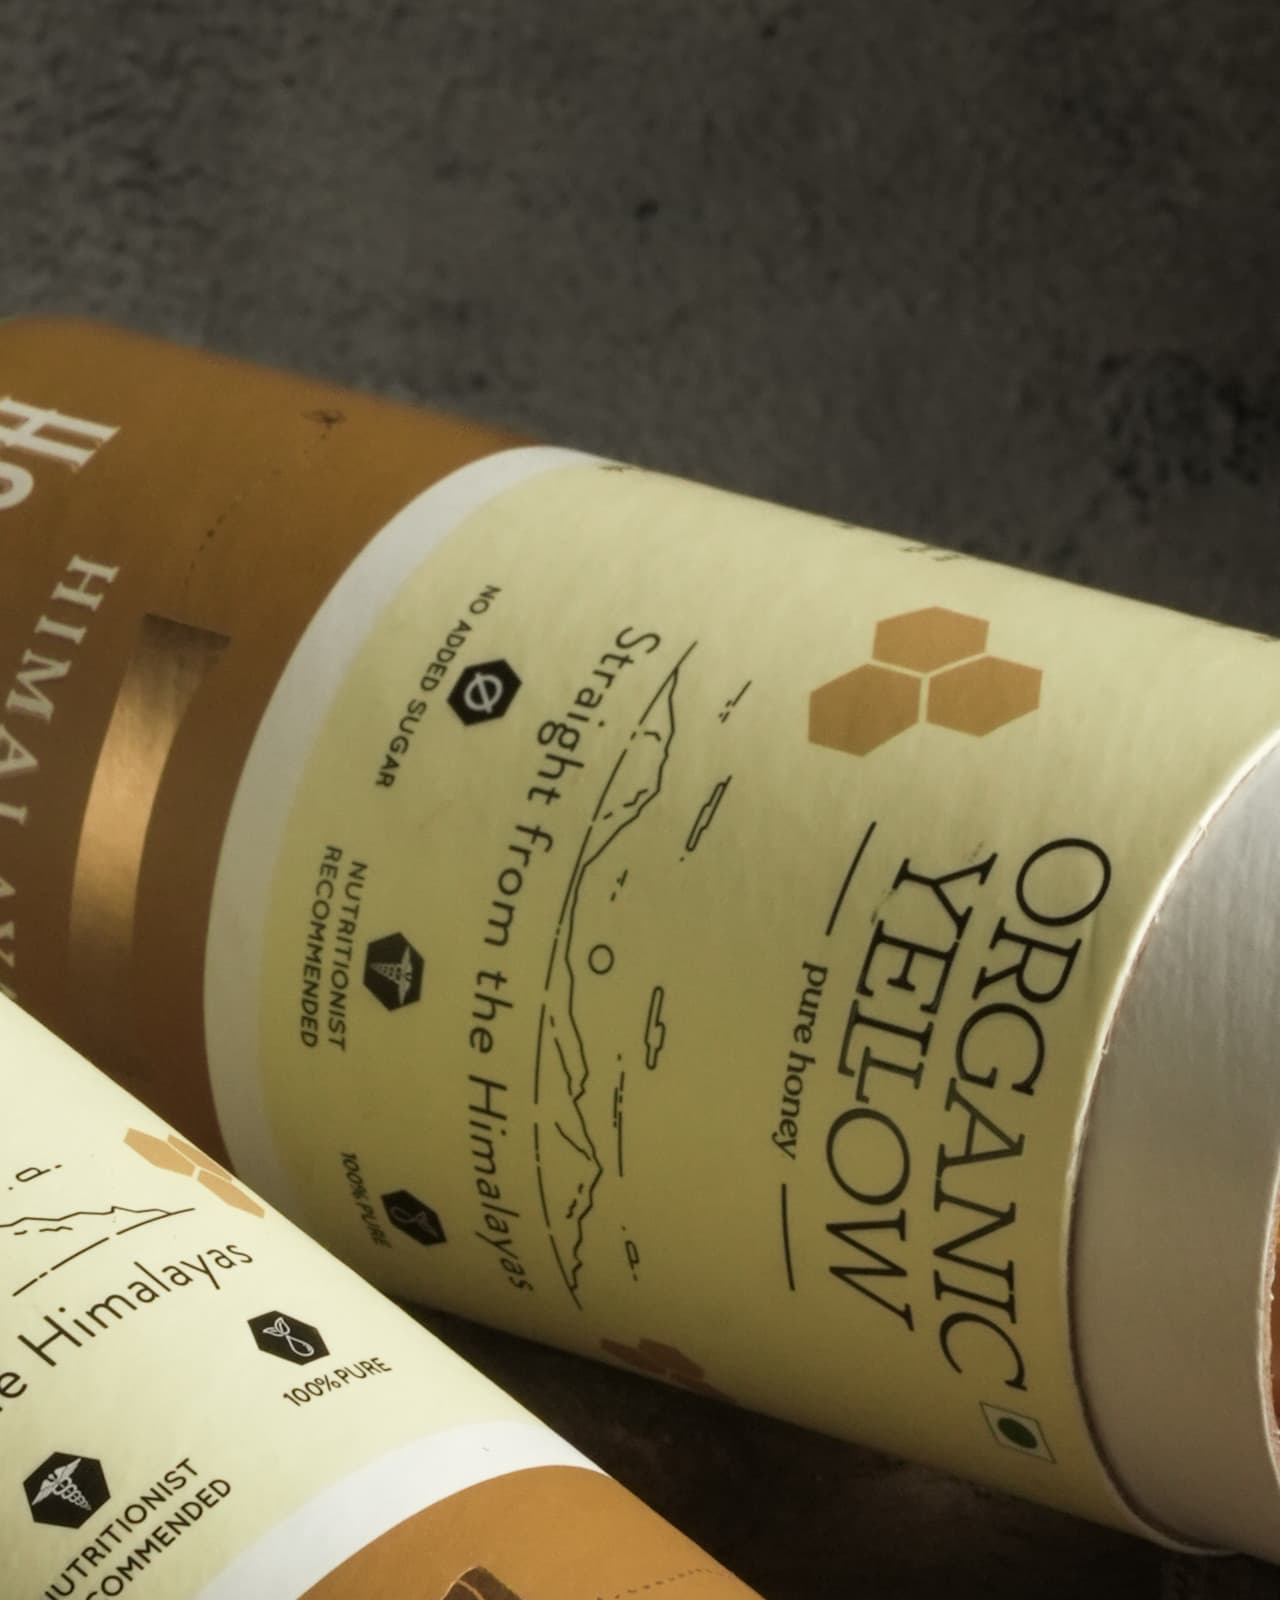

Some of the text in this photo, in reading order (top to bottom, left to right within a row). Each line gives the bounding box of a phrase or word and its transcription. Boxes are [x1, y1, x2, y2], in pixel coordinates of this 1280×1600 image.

[375, 584, 502, 789] NO ADDED SUGAR
[299, 845, 343, 1048] RECOMMENDED
[327, 860, 368, 1053] NUTRITIONIST
[467, 625, 662, 1292] Straight from the Himalayas
[770, 960, 829, 1160] pure honey
[825, 852, 999, 1332] YELLOW
[932, 837, 1113, 1393] ORGANIC
[18, 1242, 254, 1369] Himalayas
